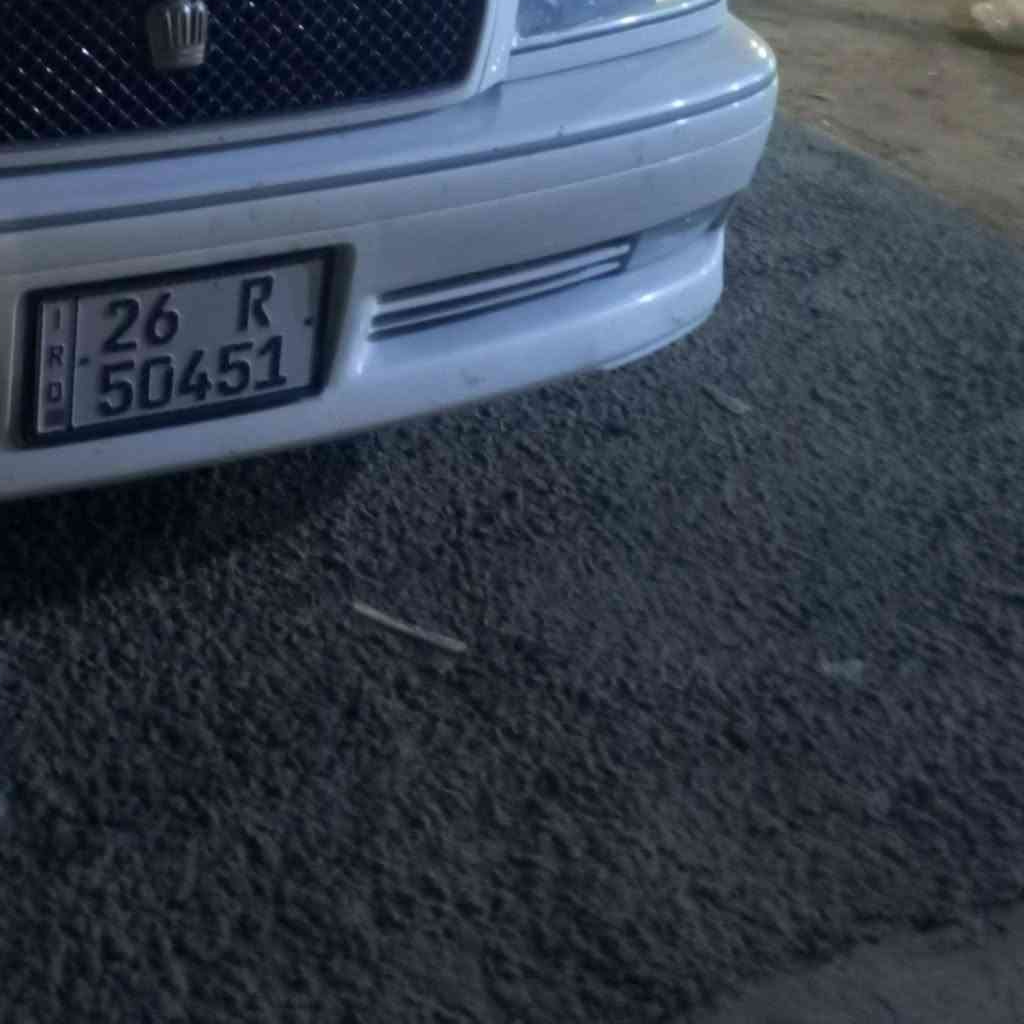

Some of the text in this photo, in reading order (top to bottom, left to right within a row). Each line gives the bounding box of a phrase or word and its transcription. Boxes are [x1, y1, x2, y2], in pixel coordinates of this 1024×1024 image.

[102, 275, 275, 353] 26 R
[96, 335, 288, 416] 50451
